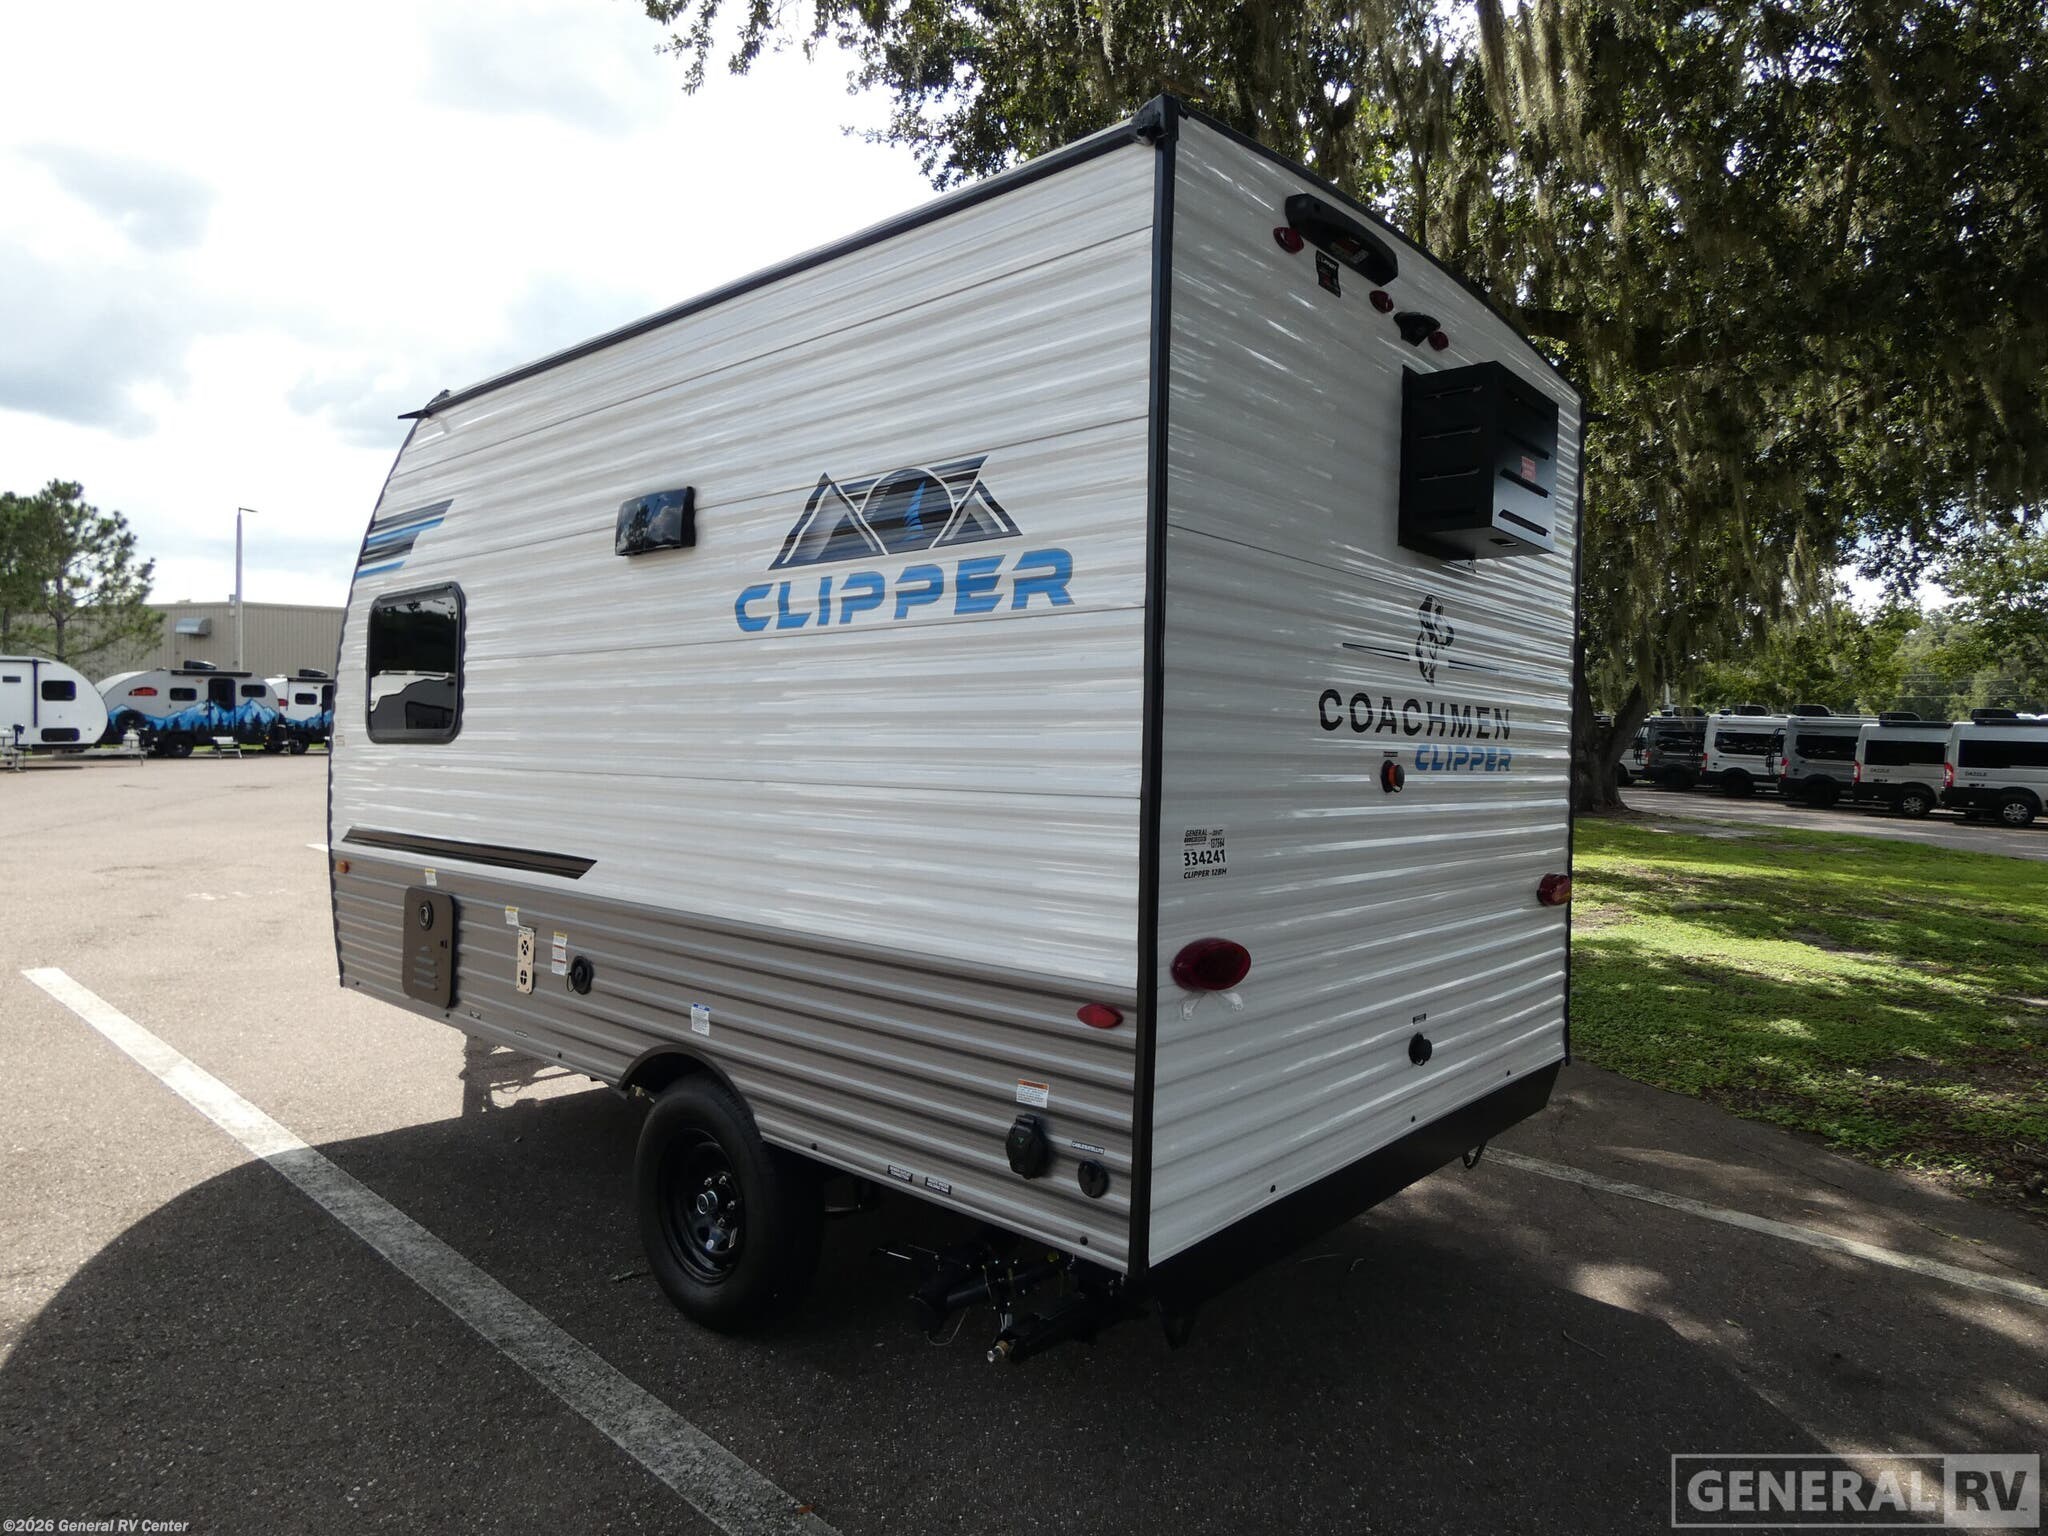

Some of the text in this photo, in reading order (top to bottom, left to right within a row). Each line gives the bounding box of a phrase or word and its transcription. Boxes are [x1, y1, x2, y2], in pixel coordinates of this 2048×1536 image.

[734, 548, 1075, 632] CLIPPER
[1318, 689, 1511, 740] COACHMEN
[1415, 745, 1512, 771] CLIPPER
[1183, 849, 1226, 866] 334241
[1183, 869, 1210, 879] CLIPPER
